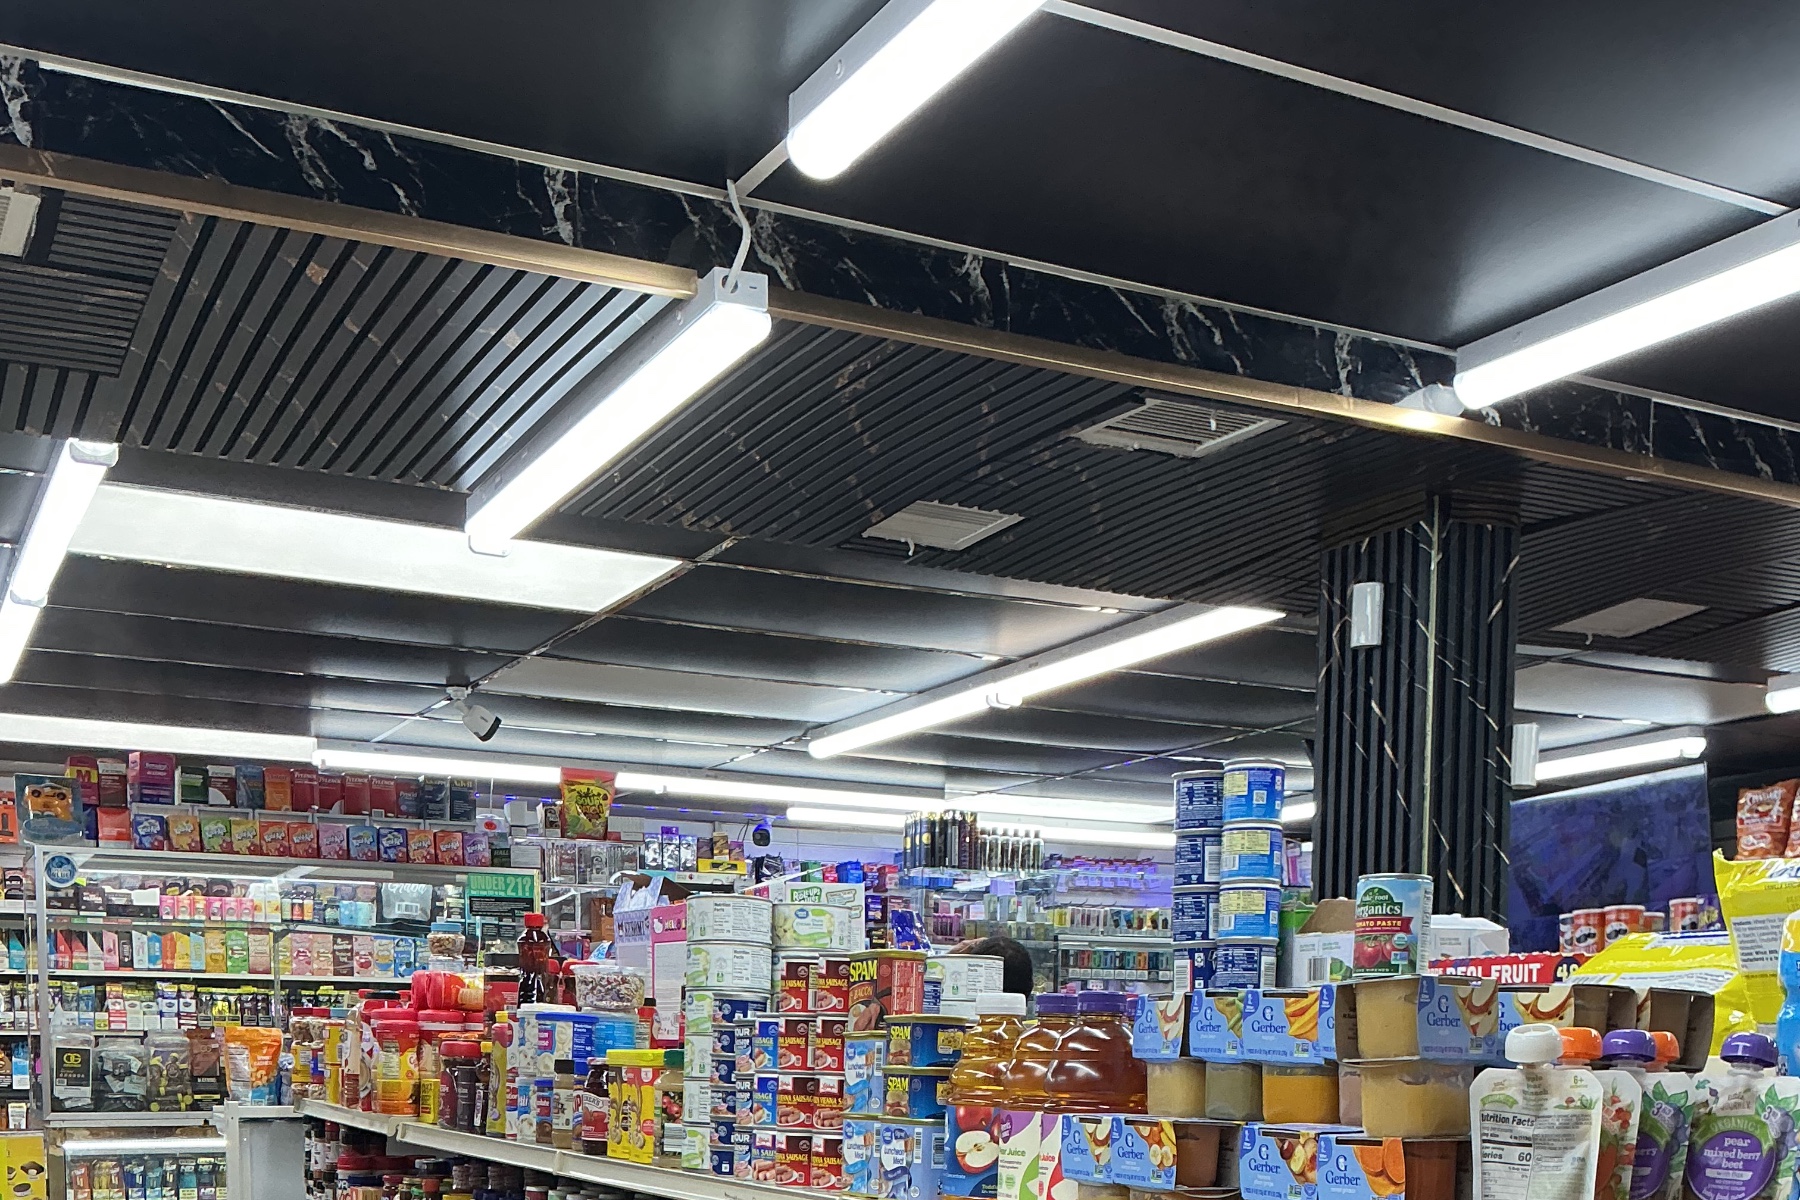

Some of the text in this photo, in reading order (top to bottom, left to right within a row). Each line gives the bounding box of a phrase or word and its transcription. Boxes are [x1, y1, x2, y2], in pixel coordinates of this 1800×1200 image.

[471, 875, 505, 891] UNDER
[507, 875, 532, 897] 21?
[1376, 919, 1401, 927] PASTE
[850, 960, 877, 982] SPAM
[1490, 963, 1542, 983] FRUIT
[1427, 1014, 1461, 1027] Gerber
[891, 1026, 911, 1040] SPAM
[1138, 1023, 1158, 1034] Gerber
[1196, 1022, 1221, 1032] Gerber
[1252, 1021, 1286, 1034] Gerber
[888, 1077, 909, 1092] SPAM
[1512, 1116, 1534, 1127] Facts
[1724, 1136, 1751, 1148] pear
[1007, 1148, 1026, 1157] Juice
[1067, 1144, 1088, 1155] Gerber
[1117, 1148, 1144, 1160] Gerber
[1704, 1147, 1732, 1158] mixed
[1518, 1151, 1532, 1163] 60
[1248, 1159, 1281, 1174] Gerber
[1721, 1159, 1743, 1169] beet
[1325, 1170, 1361, 1186] Gerber
